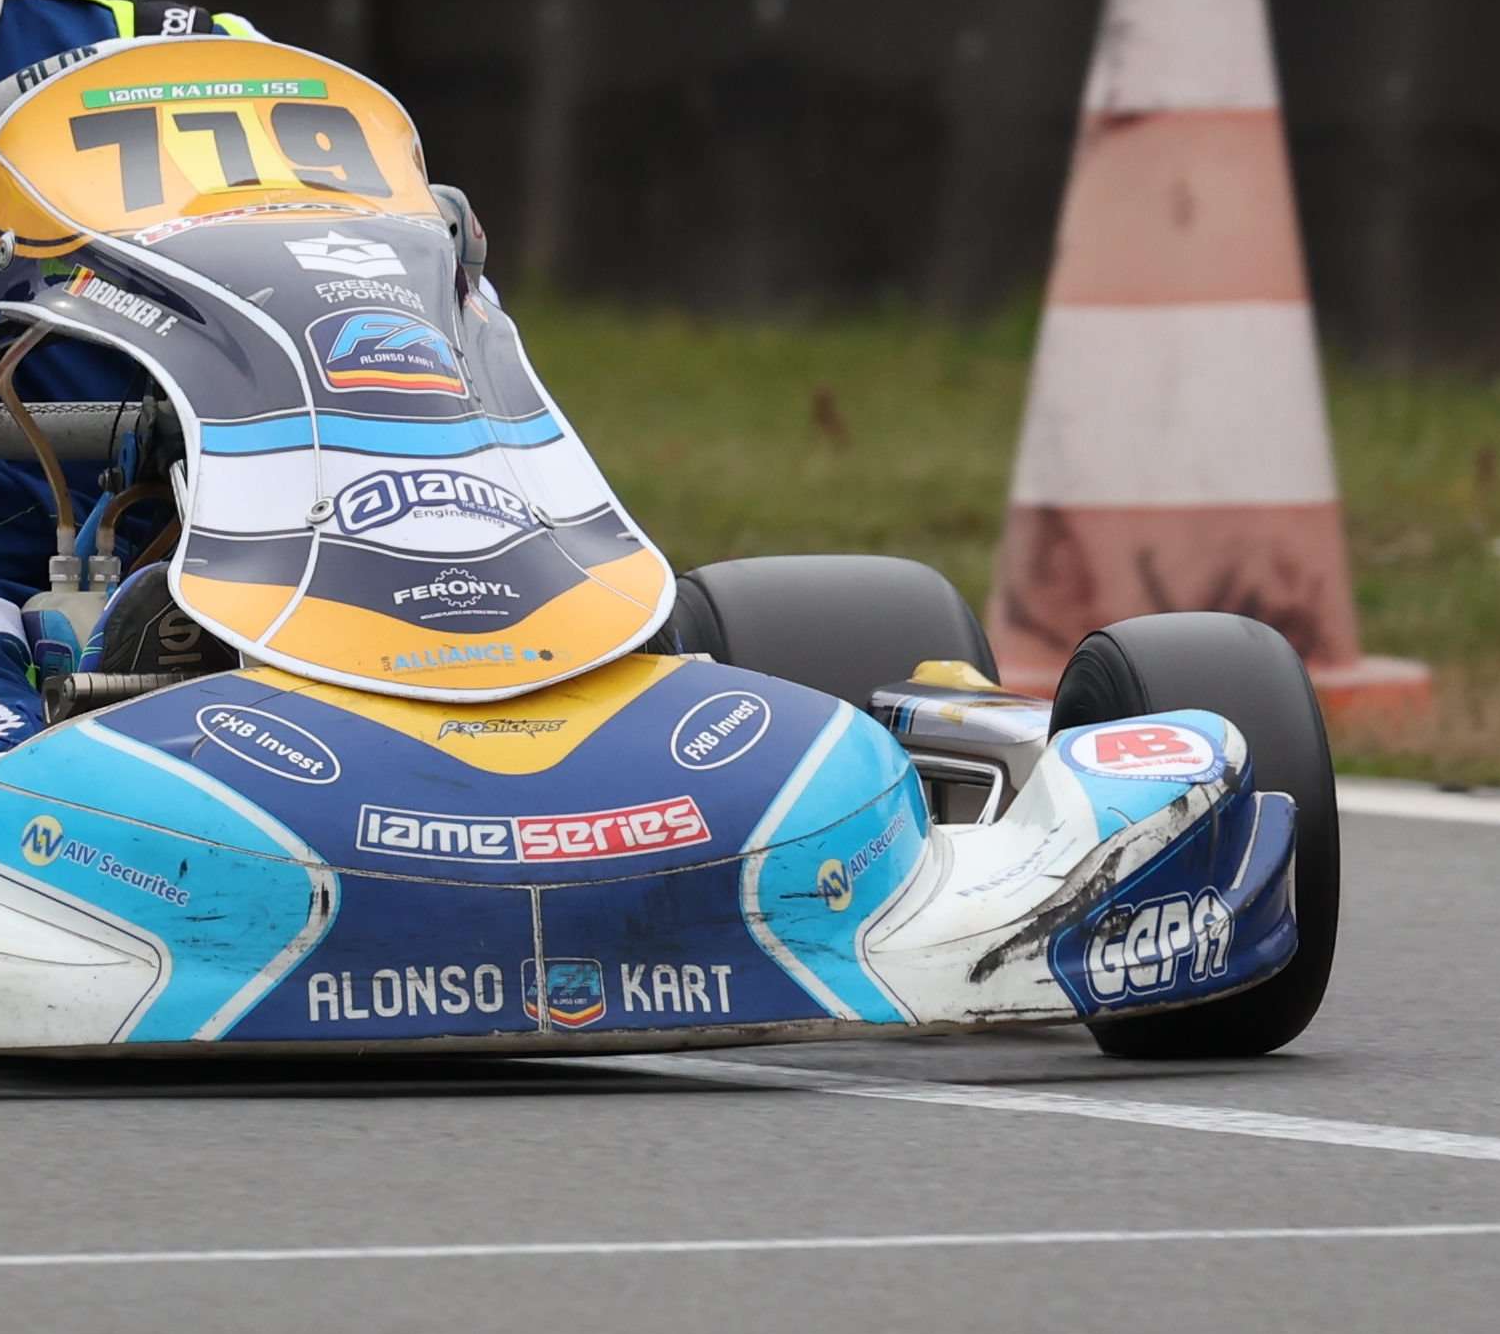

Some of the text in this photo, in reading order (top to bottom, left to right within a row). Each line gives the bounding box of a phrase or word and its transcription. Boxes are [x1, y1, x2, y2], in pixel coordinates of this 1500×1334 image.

[261, 81, 299, 95] 155
[81, 276, 179, 337] DEDECKER F.
[314, 279, 423, 302] FREEMAN
[320, 289, 427, 314] T.PORTER
[360, 354, 405, 365] ALONSO
[413, 508, 506, 530] Engineering
[393, 579, 521, 605] FERONYL
[394, 643, 517, 670] ALLIANCE
[211, 711, 325, 776] FXB Invest
[683, 698, 760, 762] FXB Invest
[1095, 727, 1193, 764] AB
[520, 803, 703, 855] series
[99, 854, 190, 907] Securitec
[1087, 890, 1233, 999] GEPA
[307, 963, 732, 1022] ALONSO KART
